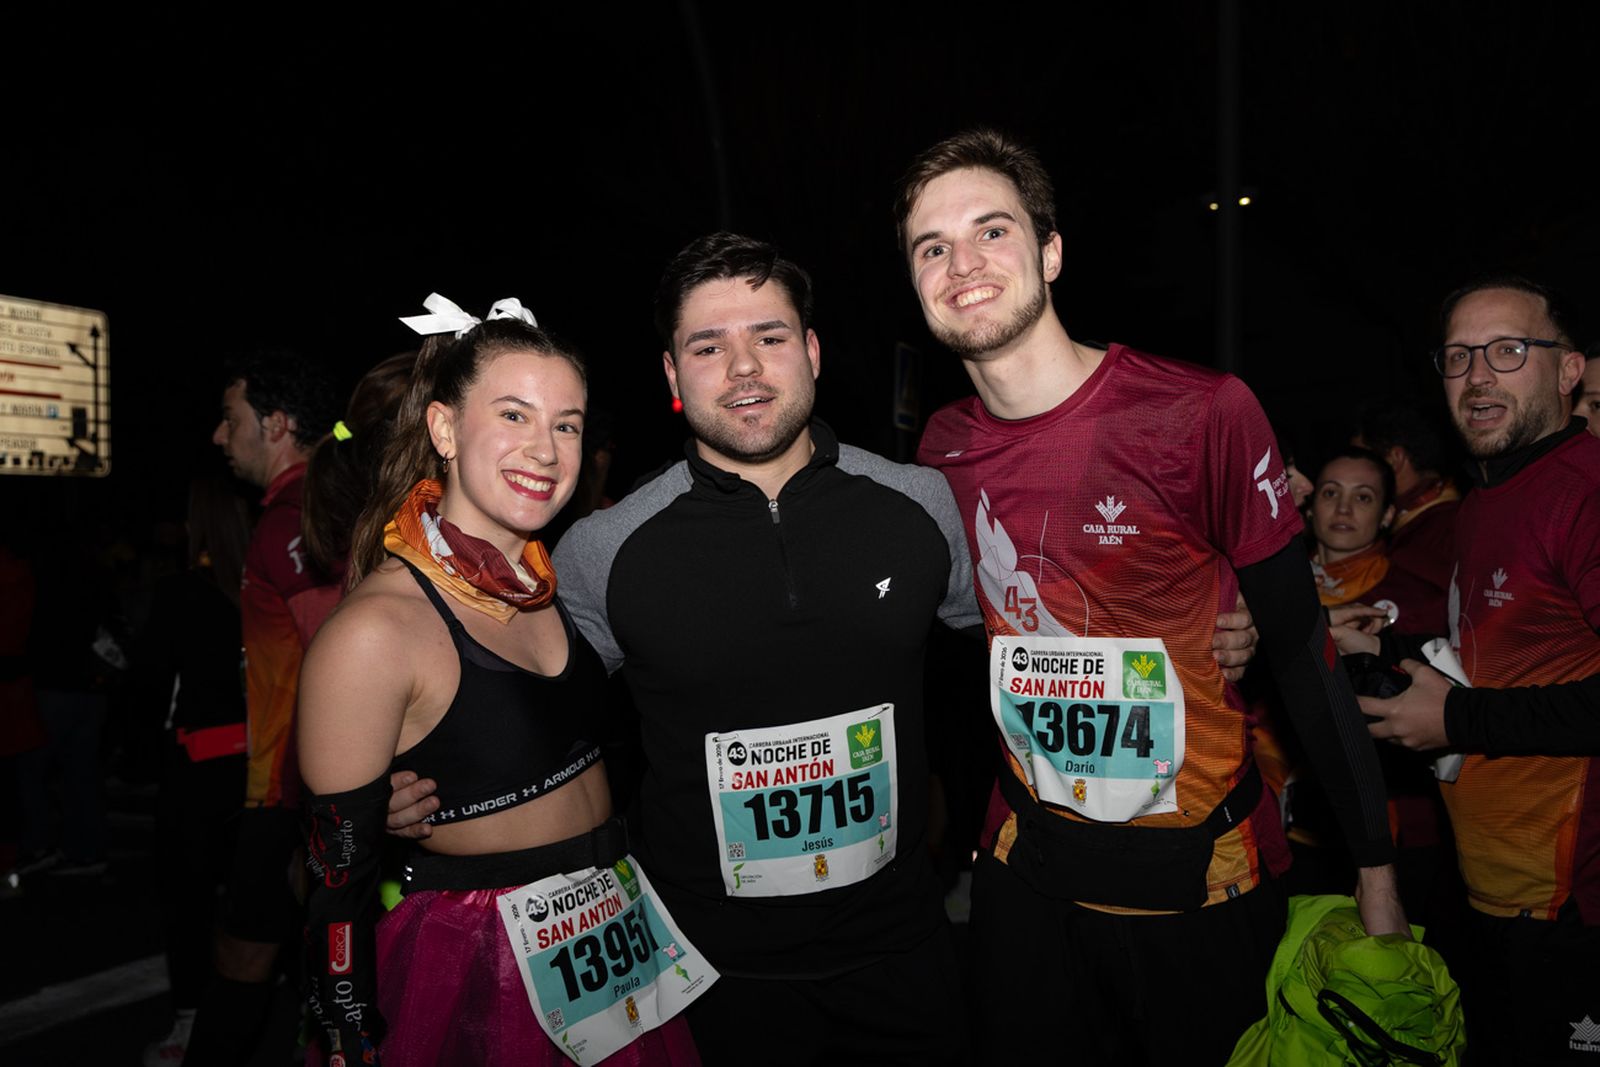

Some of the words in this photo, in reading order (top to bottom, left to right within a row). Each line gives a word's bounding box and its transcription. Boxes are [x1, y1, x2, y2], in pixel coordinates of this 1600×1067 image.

[1083, 524, 1105, 534] CAJA
[1107, 524, 1140, 535] RURAL
[1098, 533, 1123, 545] JAÉN
[1004, 586, 1040, 633] 43
[1012, 652, 1028, 665] 43
[1031, 657, 1079, 674] NOCHE
[1083, 659, 1104, 674] DE
[1010, 677, 1045, 696] SAN
[1047, 675, 1105, 699] ANTÓN
[748, 739, 772, 749] CARRERA
[772, 737, 791, 746] URBANA
[792, 731, 830, 744] INTERNACIONAL
[1015, 701, 1154, 758] 13674
[728, 747, 746, 760] 43
[751, 743, 806, 766] NOCHE
[811, 738, 831, 756] DE
[732, 769, 768, 790] SAN
[773, 757, 834, 789] ANTÓN
[1065, 759, 1095, 774] Darío
[462, 793, 518, 816] UNDER
[543, 757, 587, 790] ARMOUR
[743, 772, 875, 841] 13715
[336, 819, 357, 869] Lagarto
[801, 836, 834, 852] Jesús
[548, 885, 571, 899] CARRERA
[553, 880, 600, 916] NOCHE
[597, 873, 614, 894] DE
[528, 897, 547, 915] 43
[536, 917, 575, 949] SAN
[579, 891, 623, 934] ANTÓN
[549, 902, 660, 1002] 13951
[613, 975, 641, 998] Paula
